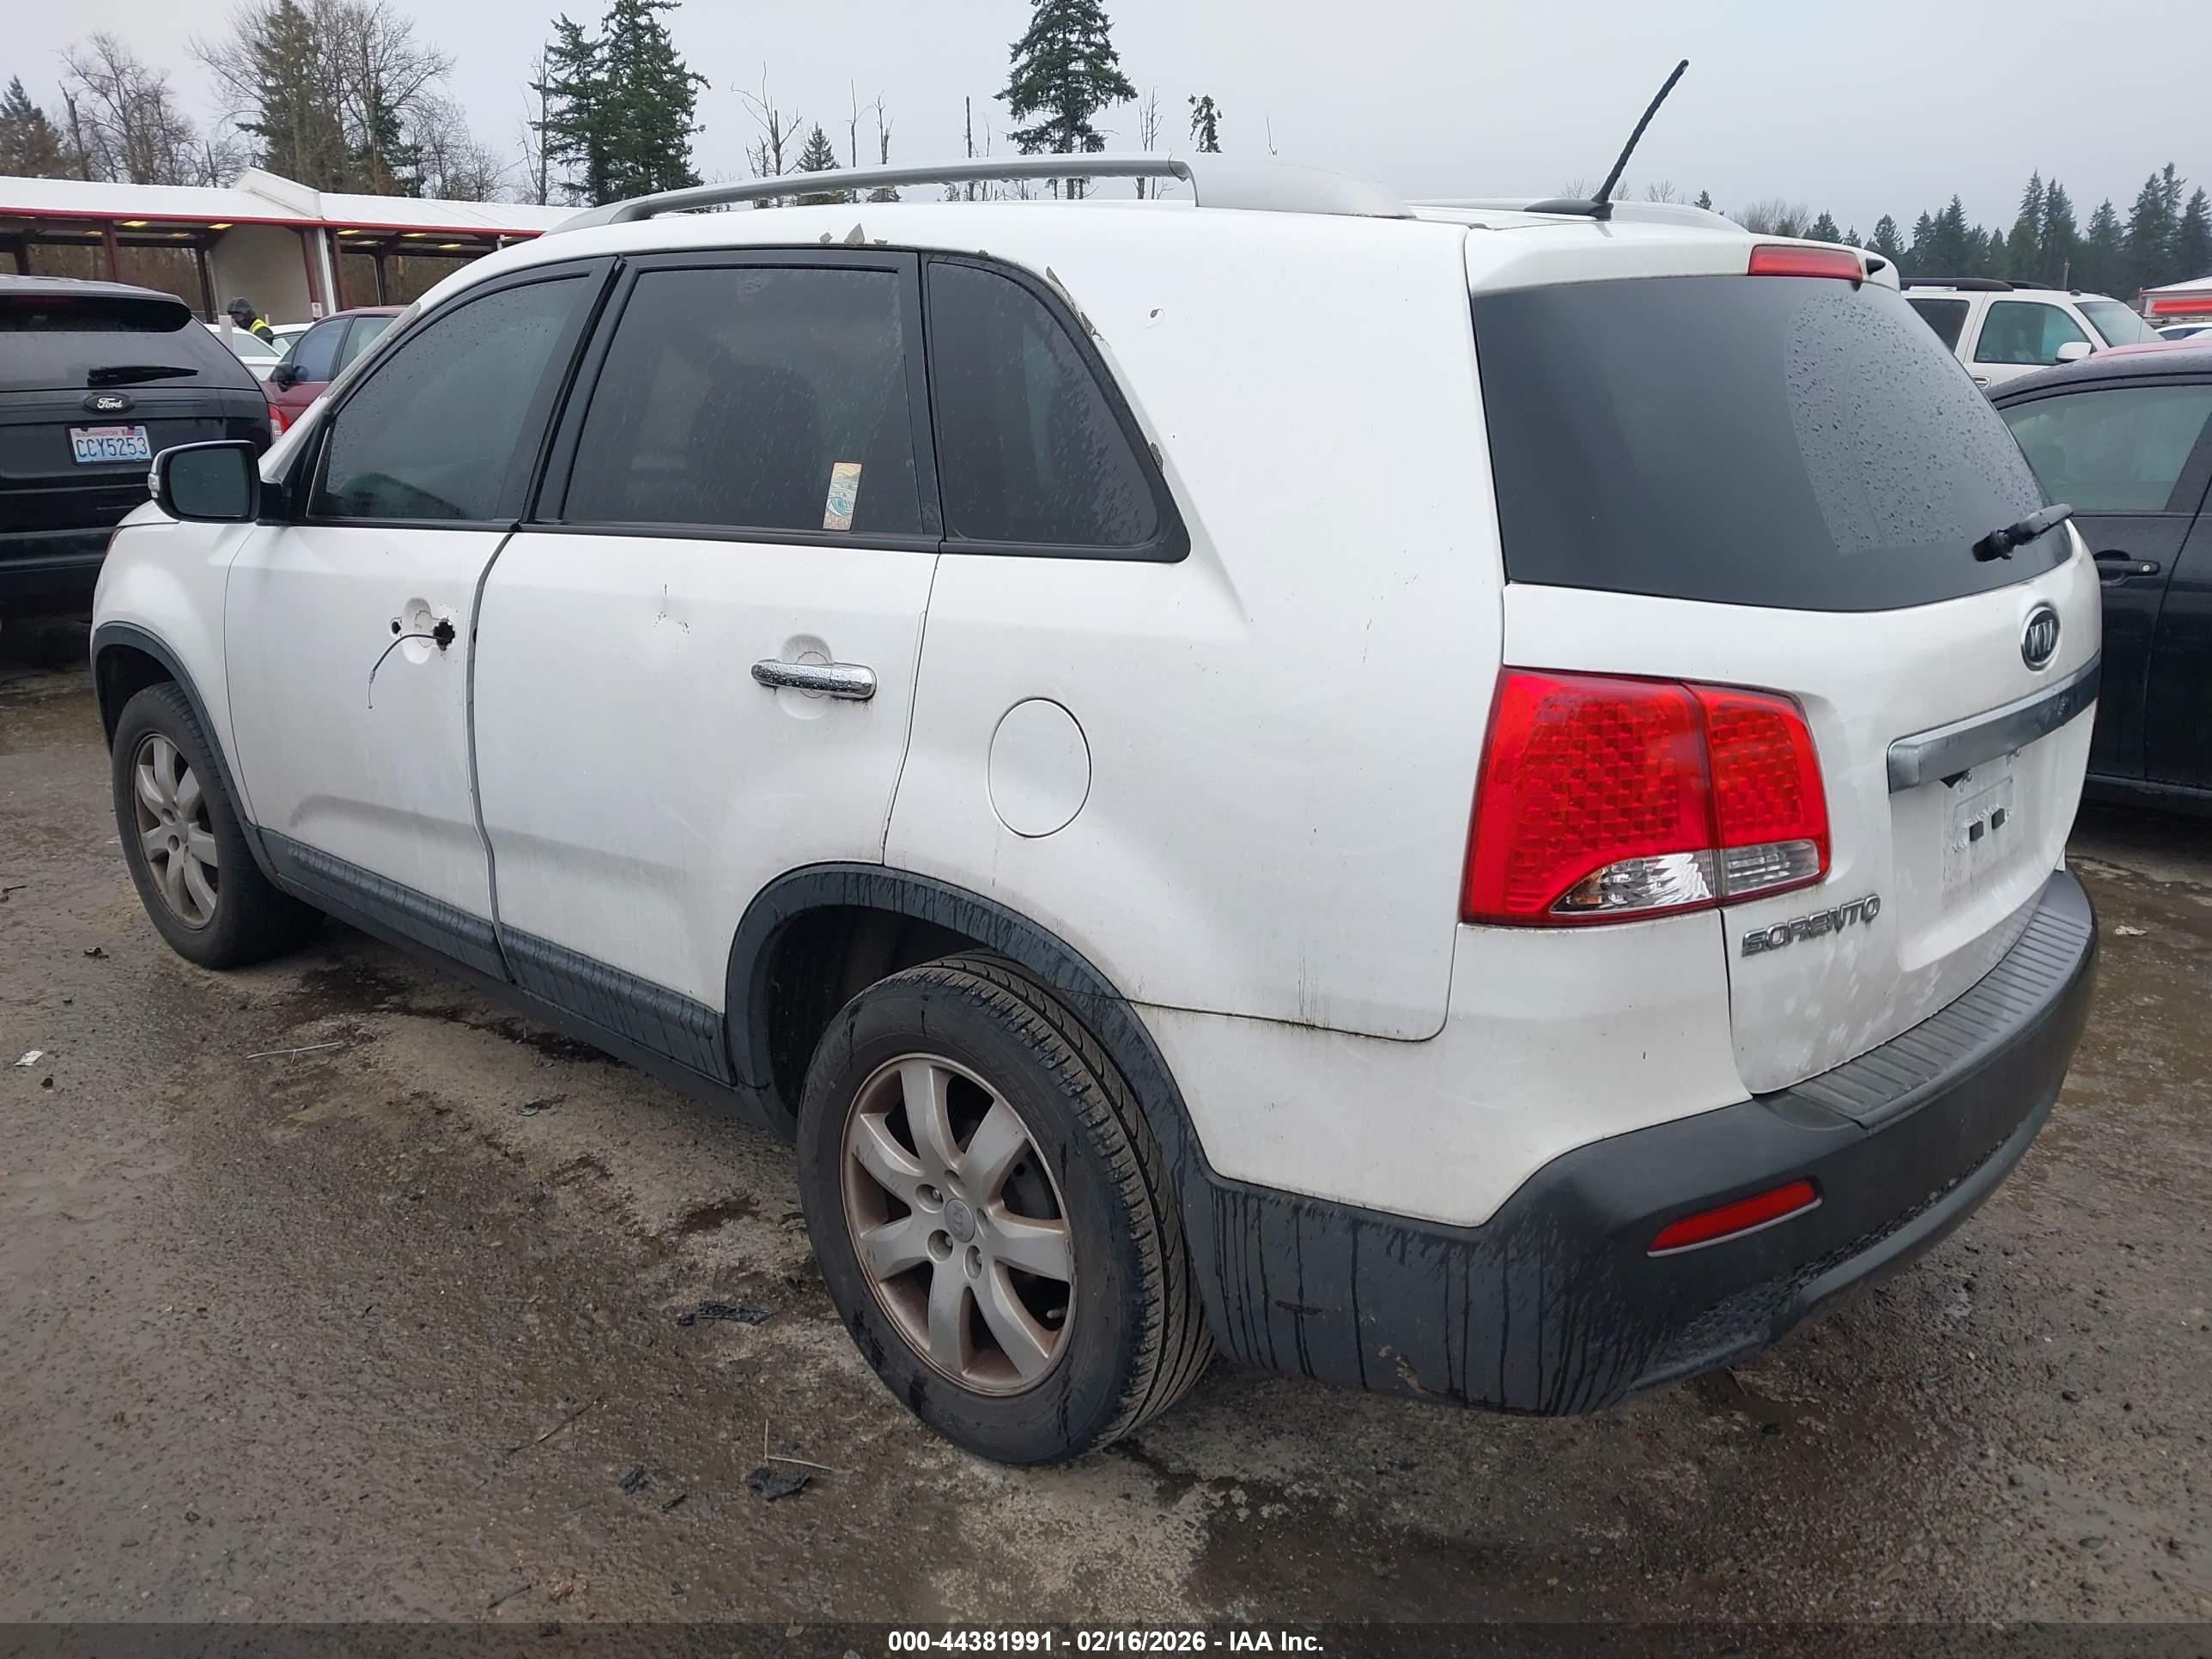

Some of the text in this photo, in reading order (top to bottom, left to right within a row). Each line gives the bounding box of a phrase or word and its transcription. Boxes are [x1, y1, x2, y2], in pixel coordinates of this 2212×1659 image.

[96, 397, 124, 409] Ford
[76, 436, 148, 458] CCY5253
[2029, 618, 2055, 658] KIA
[1741, 893, 1881, 957] SORENTO
